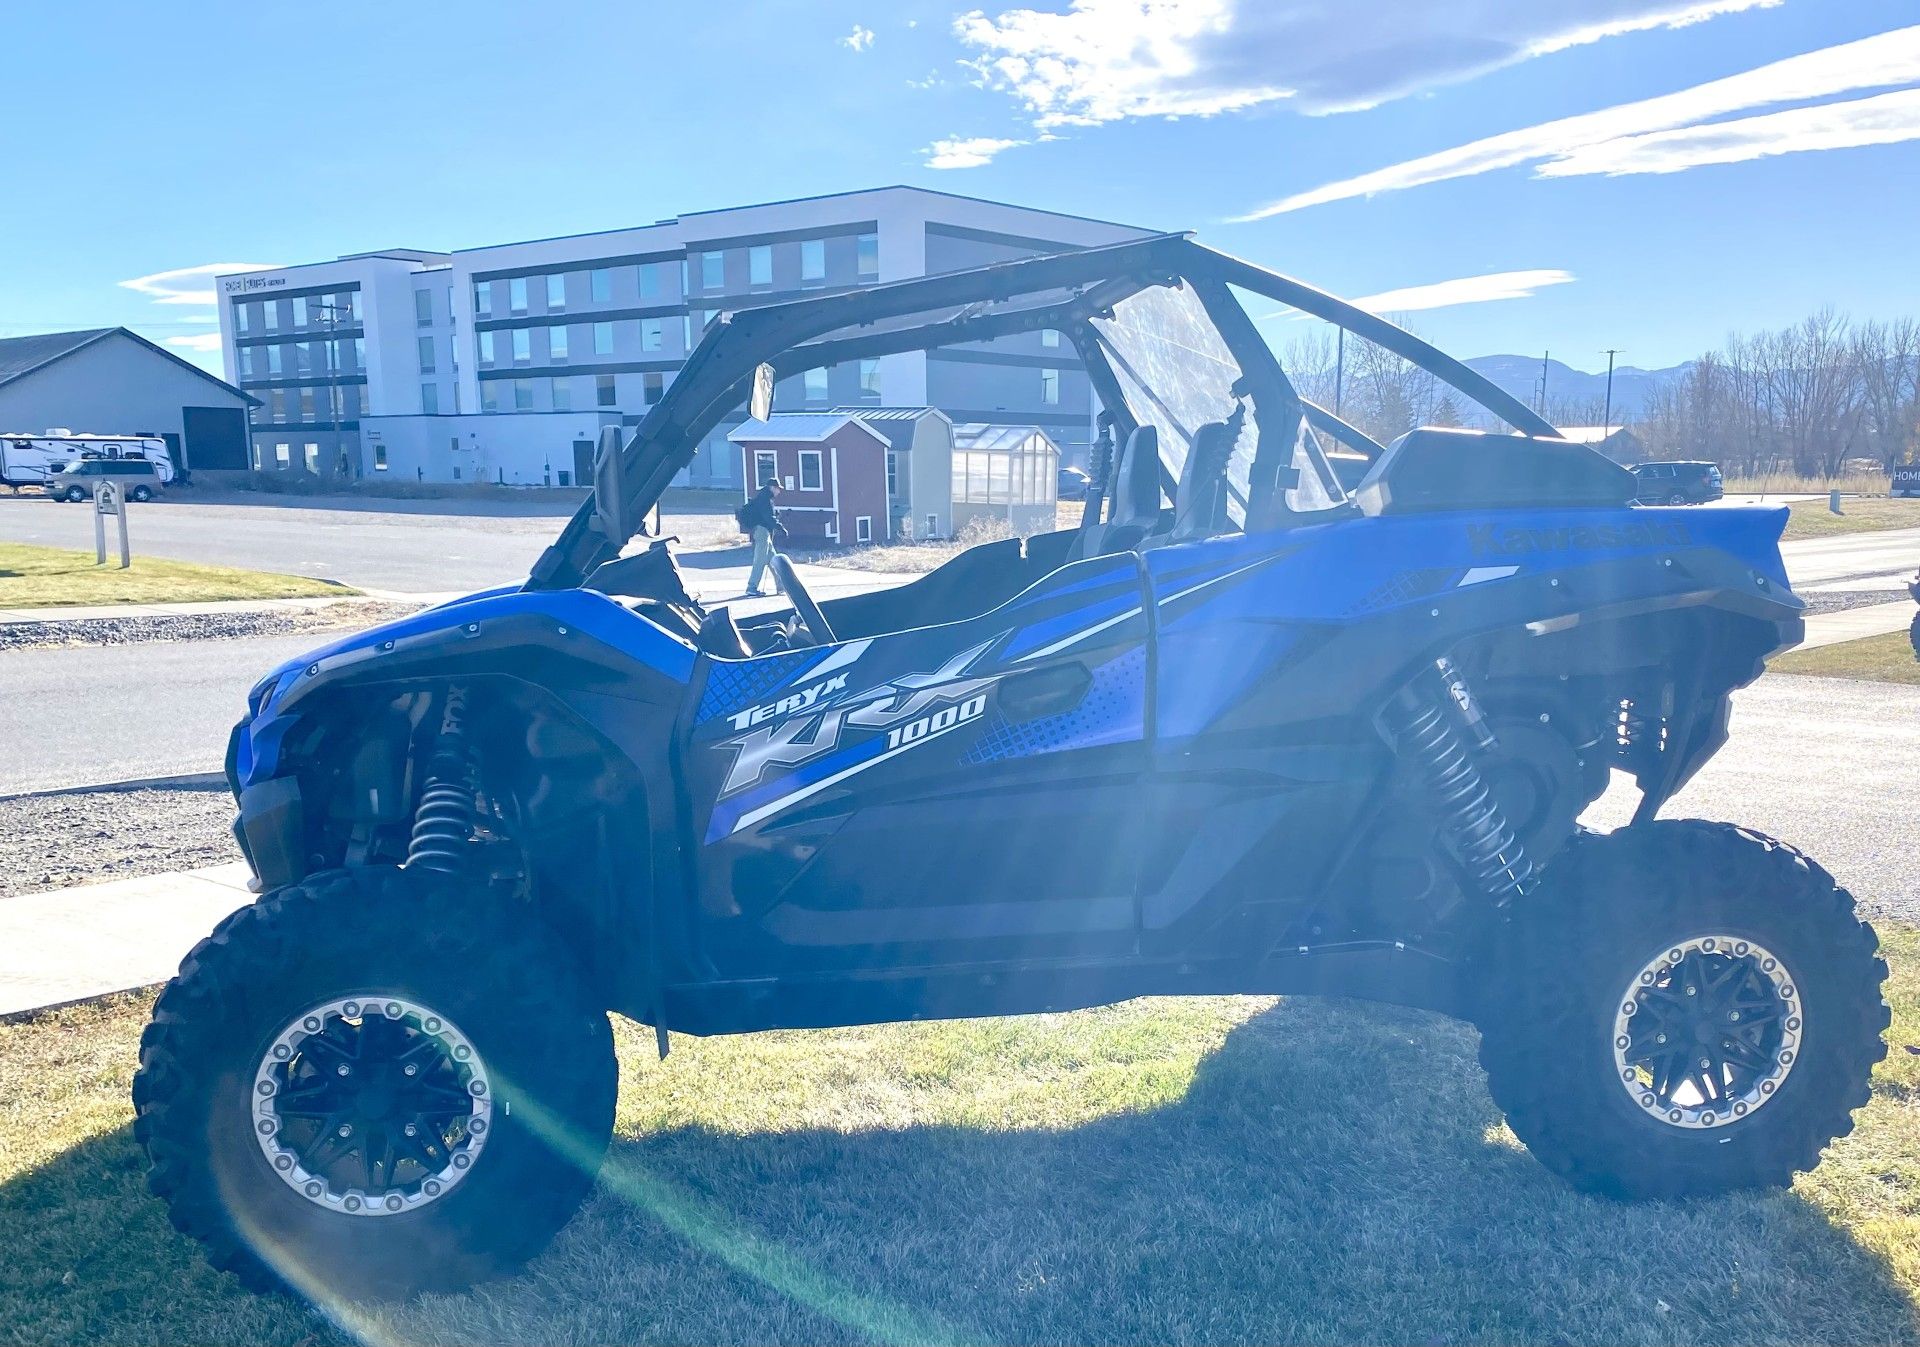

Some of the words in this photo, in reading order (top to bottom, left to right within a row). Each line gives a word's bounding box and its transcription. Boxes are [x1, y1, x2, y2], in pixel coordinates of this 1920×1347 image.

[1466, 519, 1692, 555] Kawasaki
[710, 628, 1014, 800] KRX
[726, 672, 850, 730] TERYX
[887, 695, 987, 749] 1000
